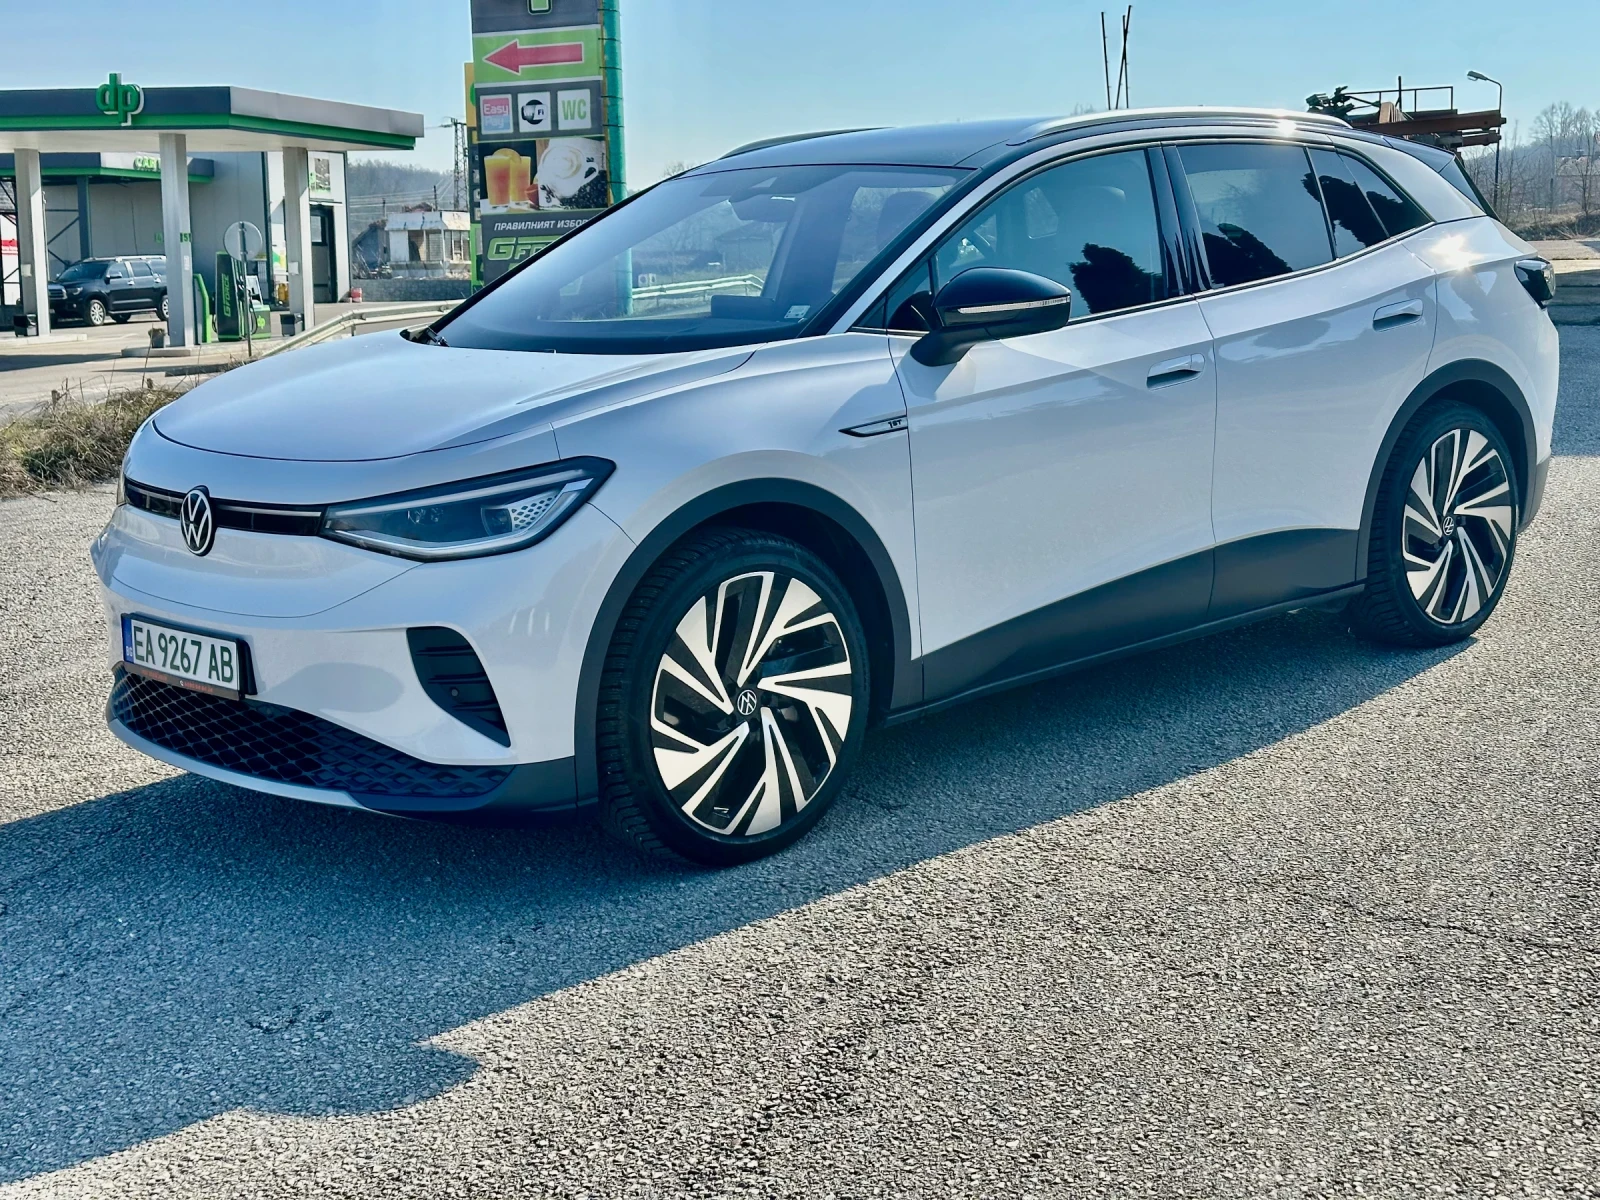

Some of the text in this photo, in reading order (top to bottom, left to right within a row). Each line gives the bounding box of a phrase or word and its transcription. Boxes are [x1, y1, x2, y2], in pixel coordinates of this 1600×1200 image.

[96, 73, 143, 126] dp
[483, 104, 508, 115] Easy
[562, 99, 587, 120] WC
[494, 220, 556, 231] ПРАВИЛНИЯТ
[133, 625, 234, 683] EA 9267 AB
